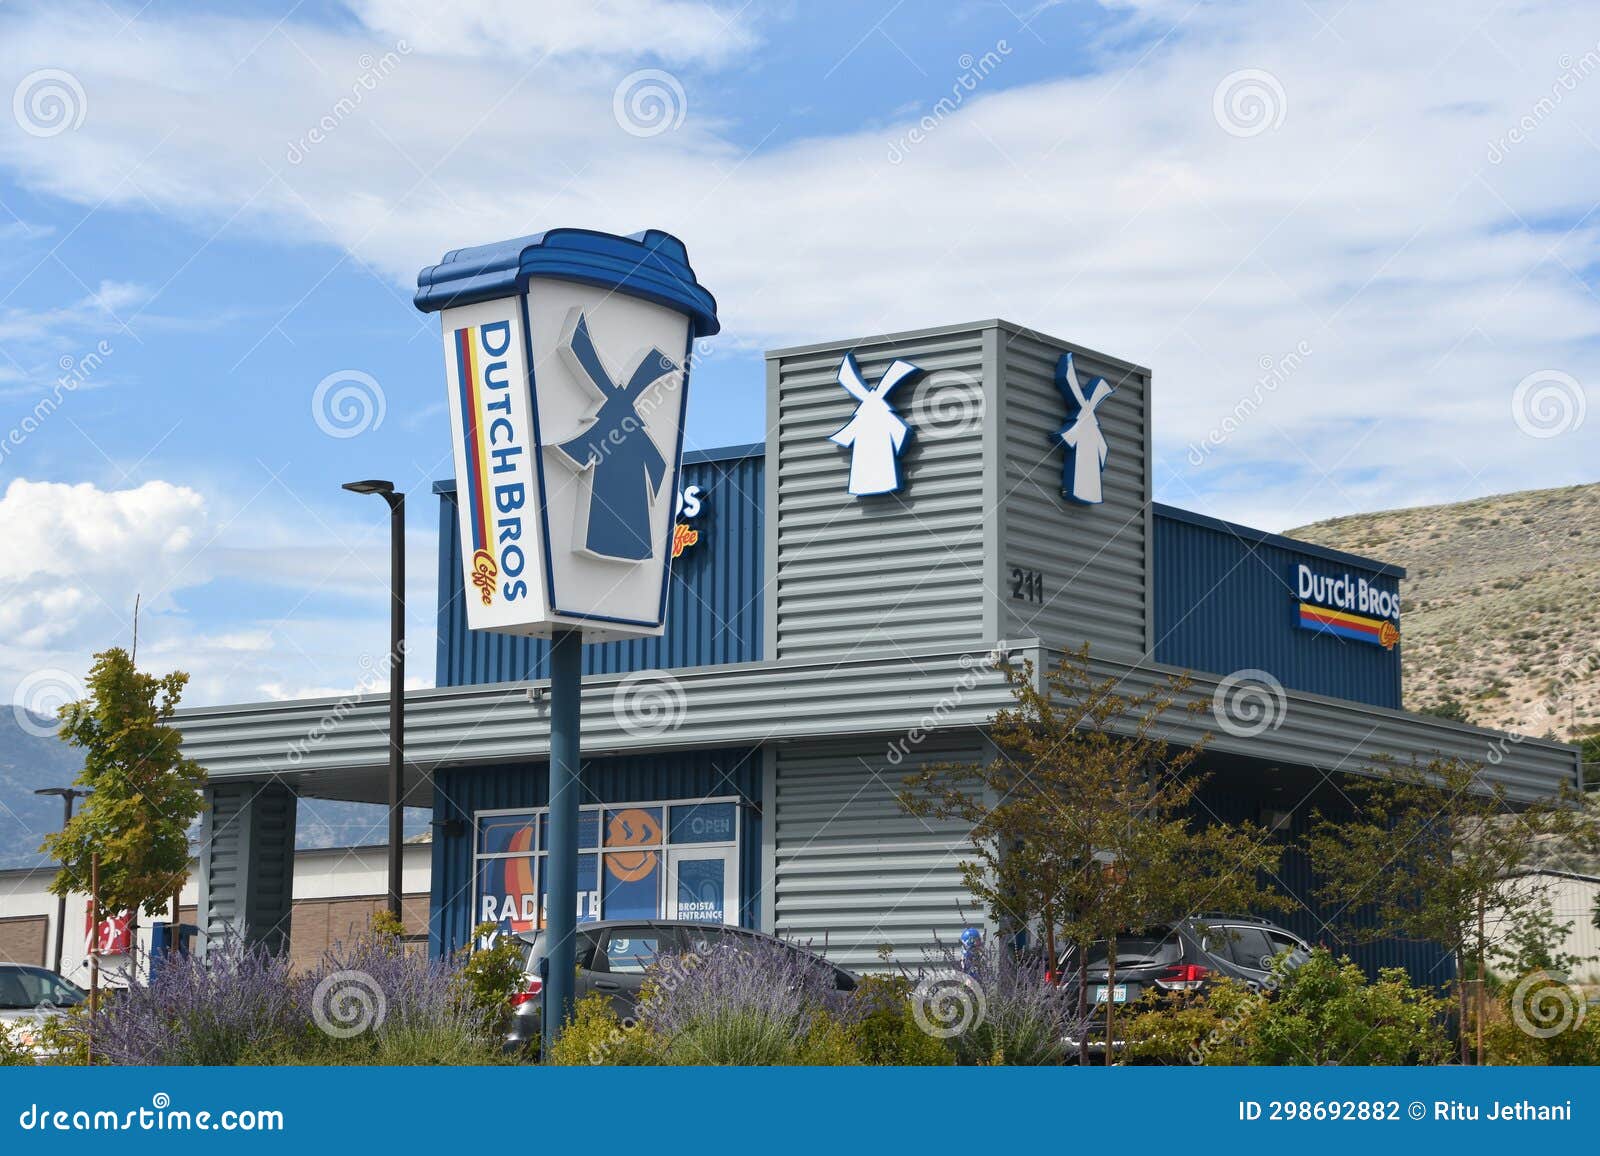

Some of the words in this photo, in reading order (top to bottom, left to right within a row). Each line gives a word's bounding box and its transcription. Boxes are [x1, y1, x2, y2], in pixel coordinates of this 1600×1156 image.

[480, 319, 525, 475] DUTCH
[494, 482, 528, 602] BROS
[471, 550, 498, 606] Coffee
[1012, 568, 1043, 604] 211
[1358, 578, 1400, 620] BROS
[691, 817, 730, 835] OPEN
[482, 891, 598, 922] RADITE
[678, 901, 715, 912] BROISTA
[678, 910, 723, 921] ENTRANCE
